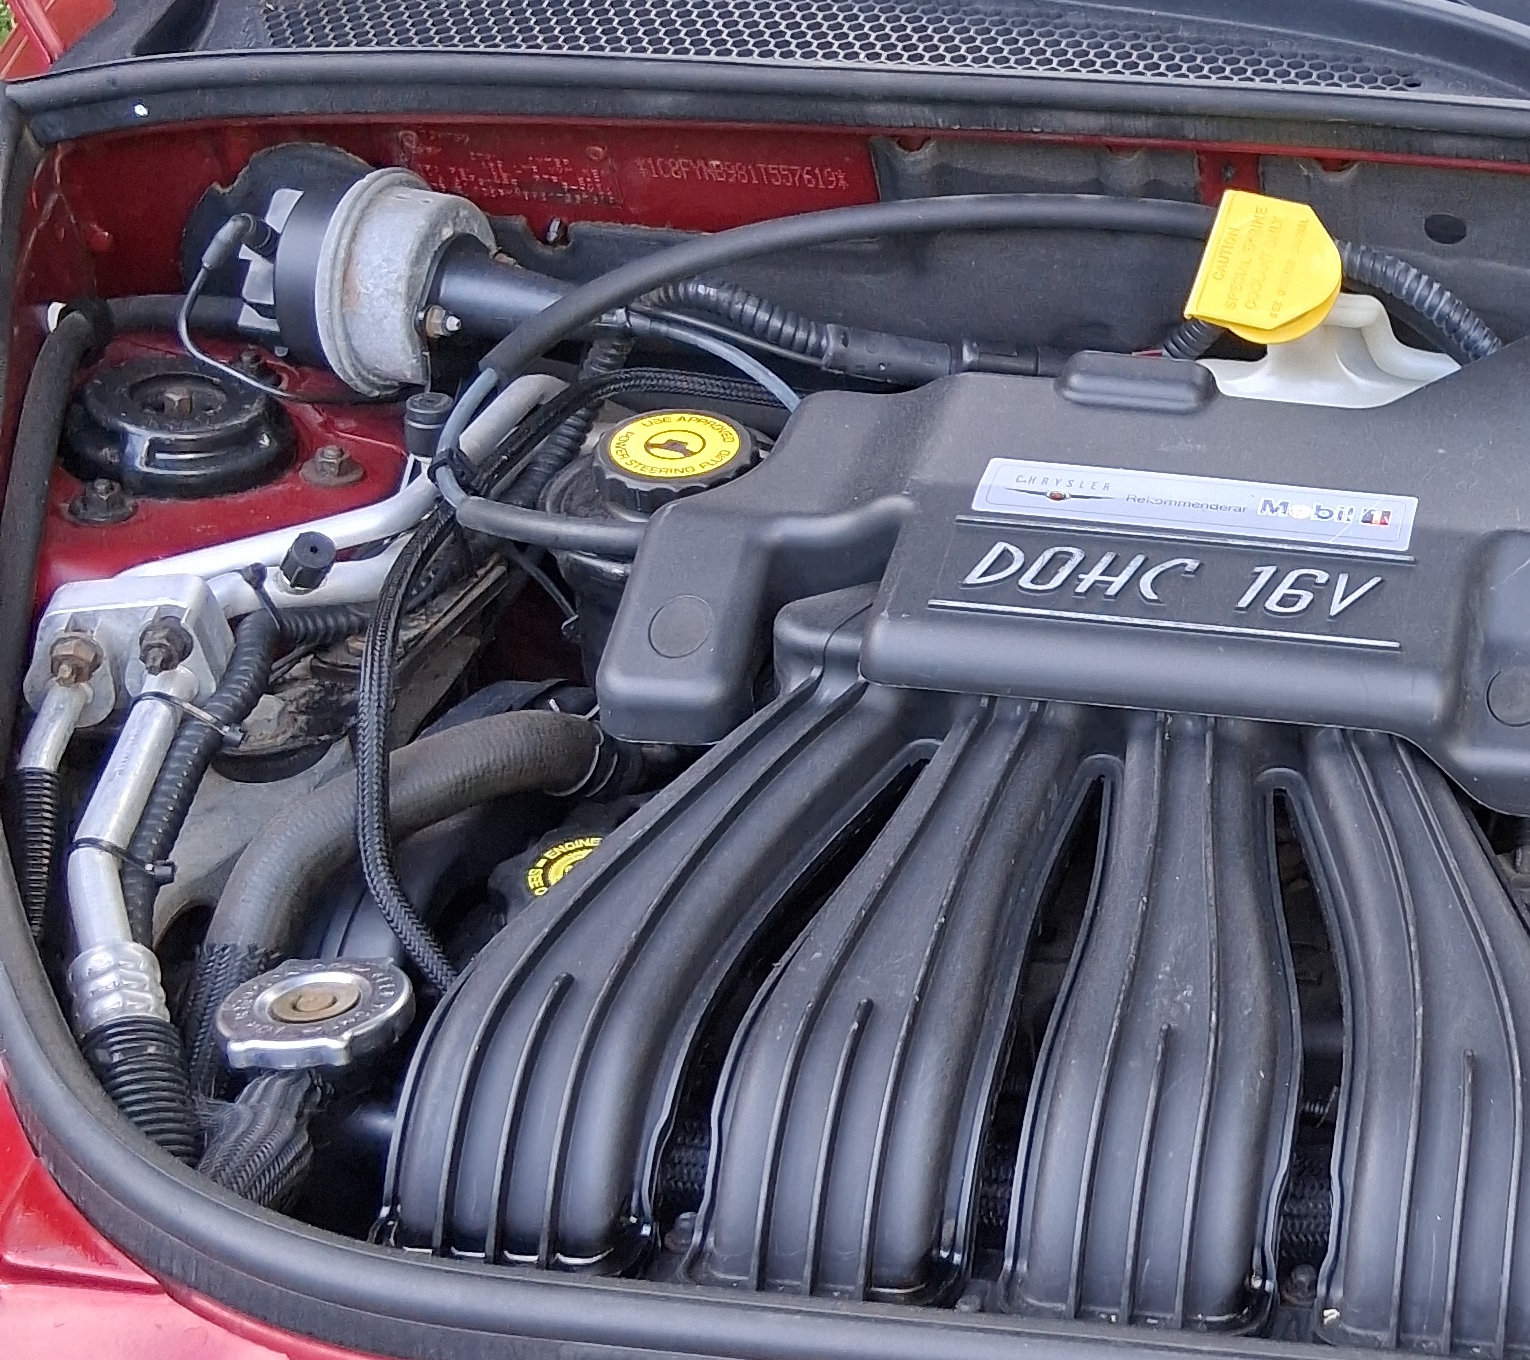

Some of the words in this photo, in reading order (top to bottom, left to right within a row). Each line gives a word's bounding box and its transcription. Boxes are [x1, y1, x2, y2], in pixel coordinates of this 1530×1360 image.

[1213, 227, 1240, 281] CAUTION
[1015, 474, 1111, 491] CHRYSLER
[1125, 493, 1248, 514] Rekommenderar
[1258, 497, 1355, 523] Mobil
[960, 541, 1203, 605] DOHC
[1235, 564, 1383, 619] 16V
